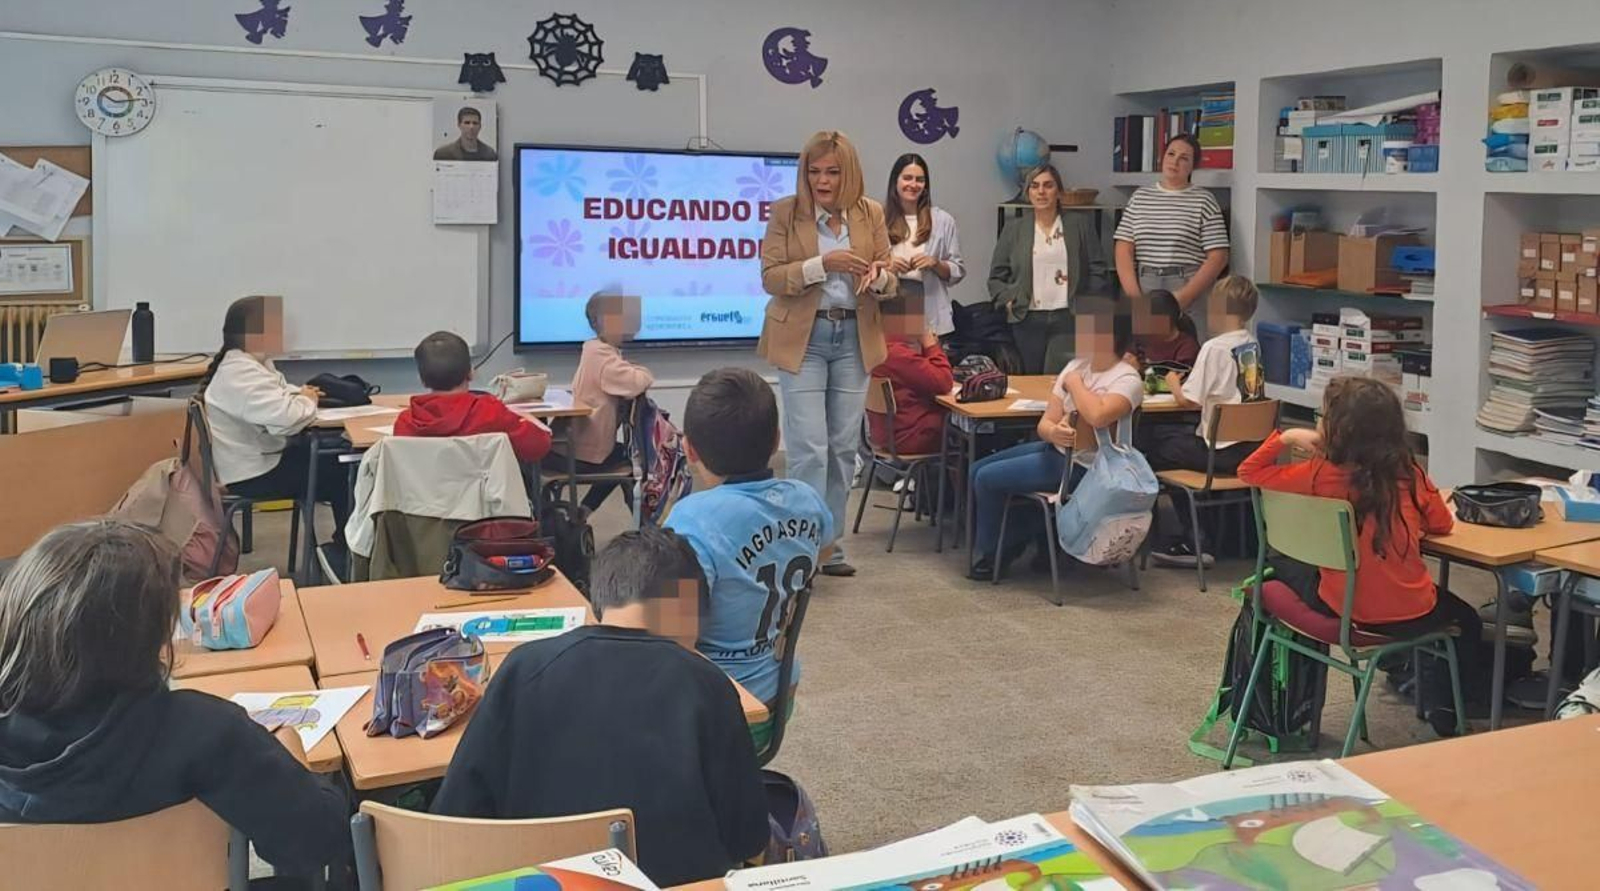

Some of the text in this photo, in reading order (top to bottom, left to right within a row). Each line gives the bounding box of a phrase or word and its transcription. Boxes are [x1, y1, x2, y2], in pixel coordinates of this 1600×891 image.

[97, 77, 105, 86] 11
[109, 74, 119, 84] 12
[85, 85, 97, 94] 10
[136, 86, 143, 96] 2
[83, 97, 90, 106] 9
[87, 108, 95, 118] 8
[137, 110, 143, 118] 4
[98, 117, 106, 129] 7
[112, 121, 120, 130] 6
[127, 118, 134, 128] 5
[583, 197, 772, 222] EDUCANDO E
[608, 237, 763, 260] IGUALDAD
[735, 525, 773, 570] IAGO
